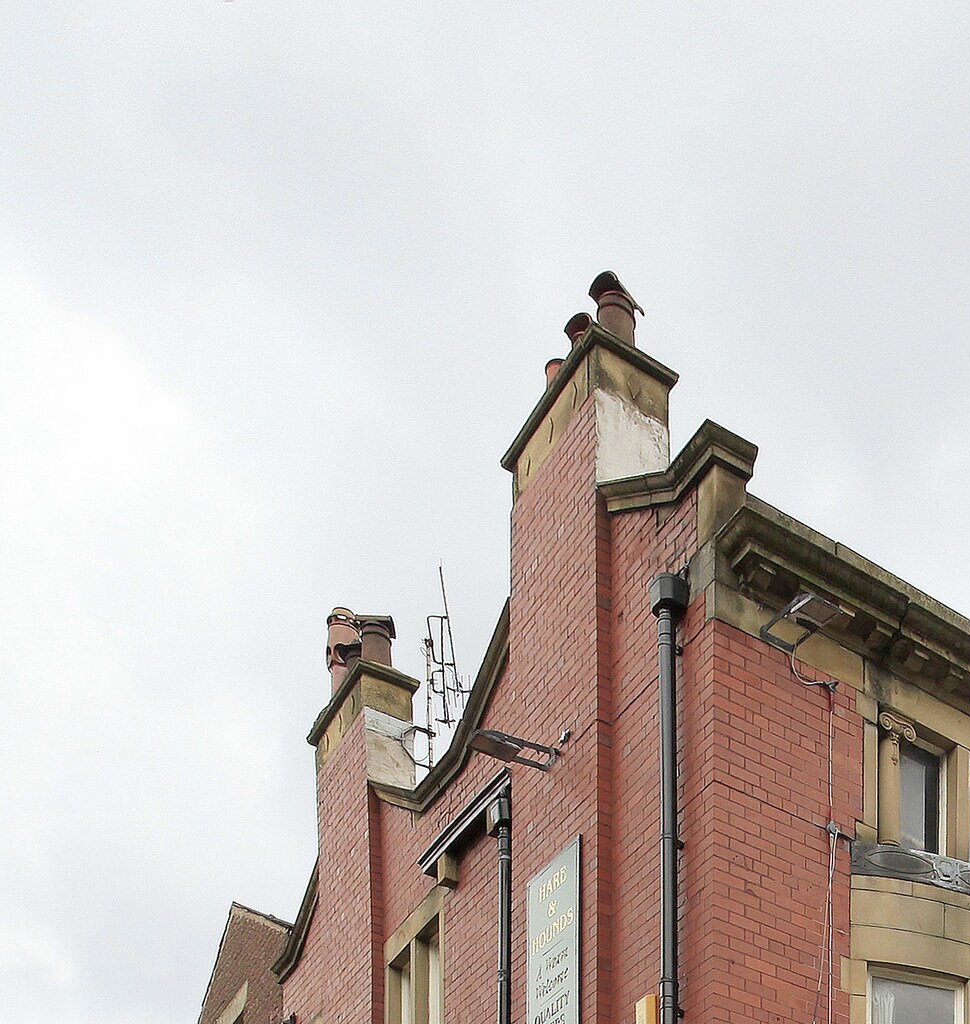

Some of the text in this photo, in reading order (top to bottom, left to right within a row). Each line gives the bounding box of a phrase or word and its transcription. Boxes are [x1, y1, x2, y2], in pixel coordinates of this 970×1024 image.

[538, 865, 568, 903] HARE
[547, 900, 557, 918] &
[532, 907, 574, 956] HOUNDS
